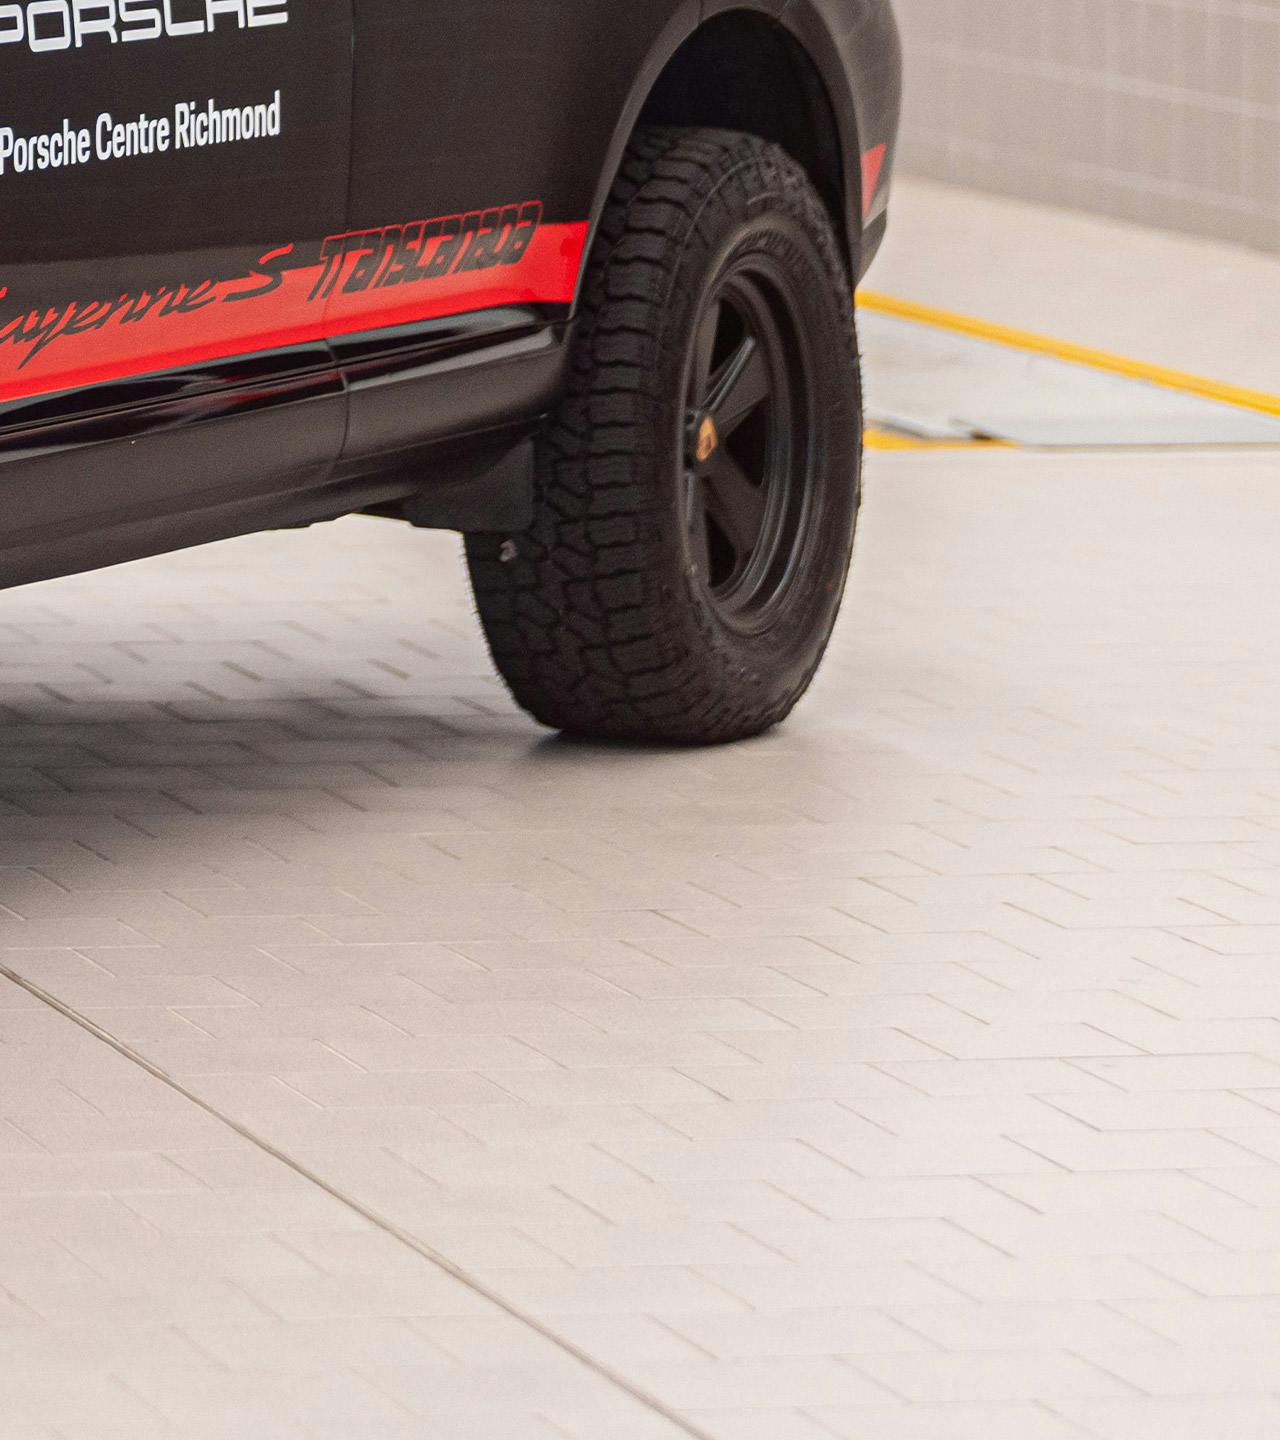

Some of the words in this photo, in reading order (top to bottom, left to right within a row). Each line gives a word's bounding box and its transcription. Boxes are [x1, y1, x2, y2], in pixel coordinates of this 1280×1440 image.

[95, 112, 171, 161] Centre
[174, 89, 281, 150] Richmond
[221, 244, 295, 303] S
